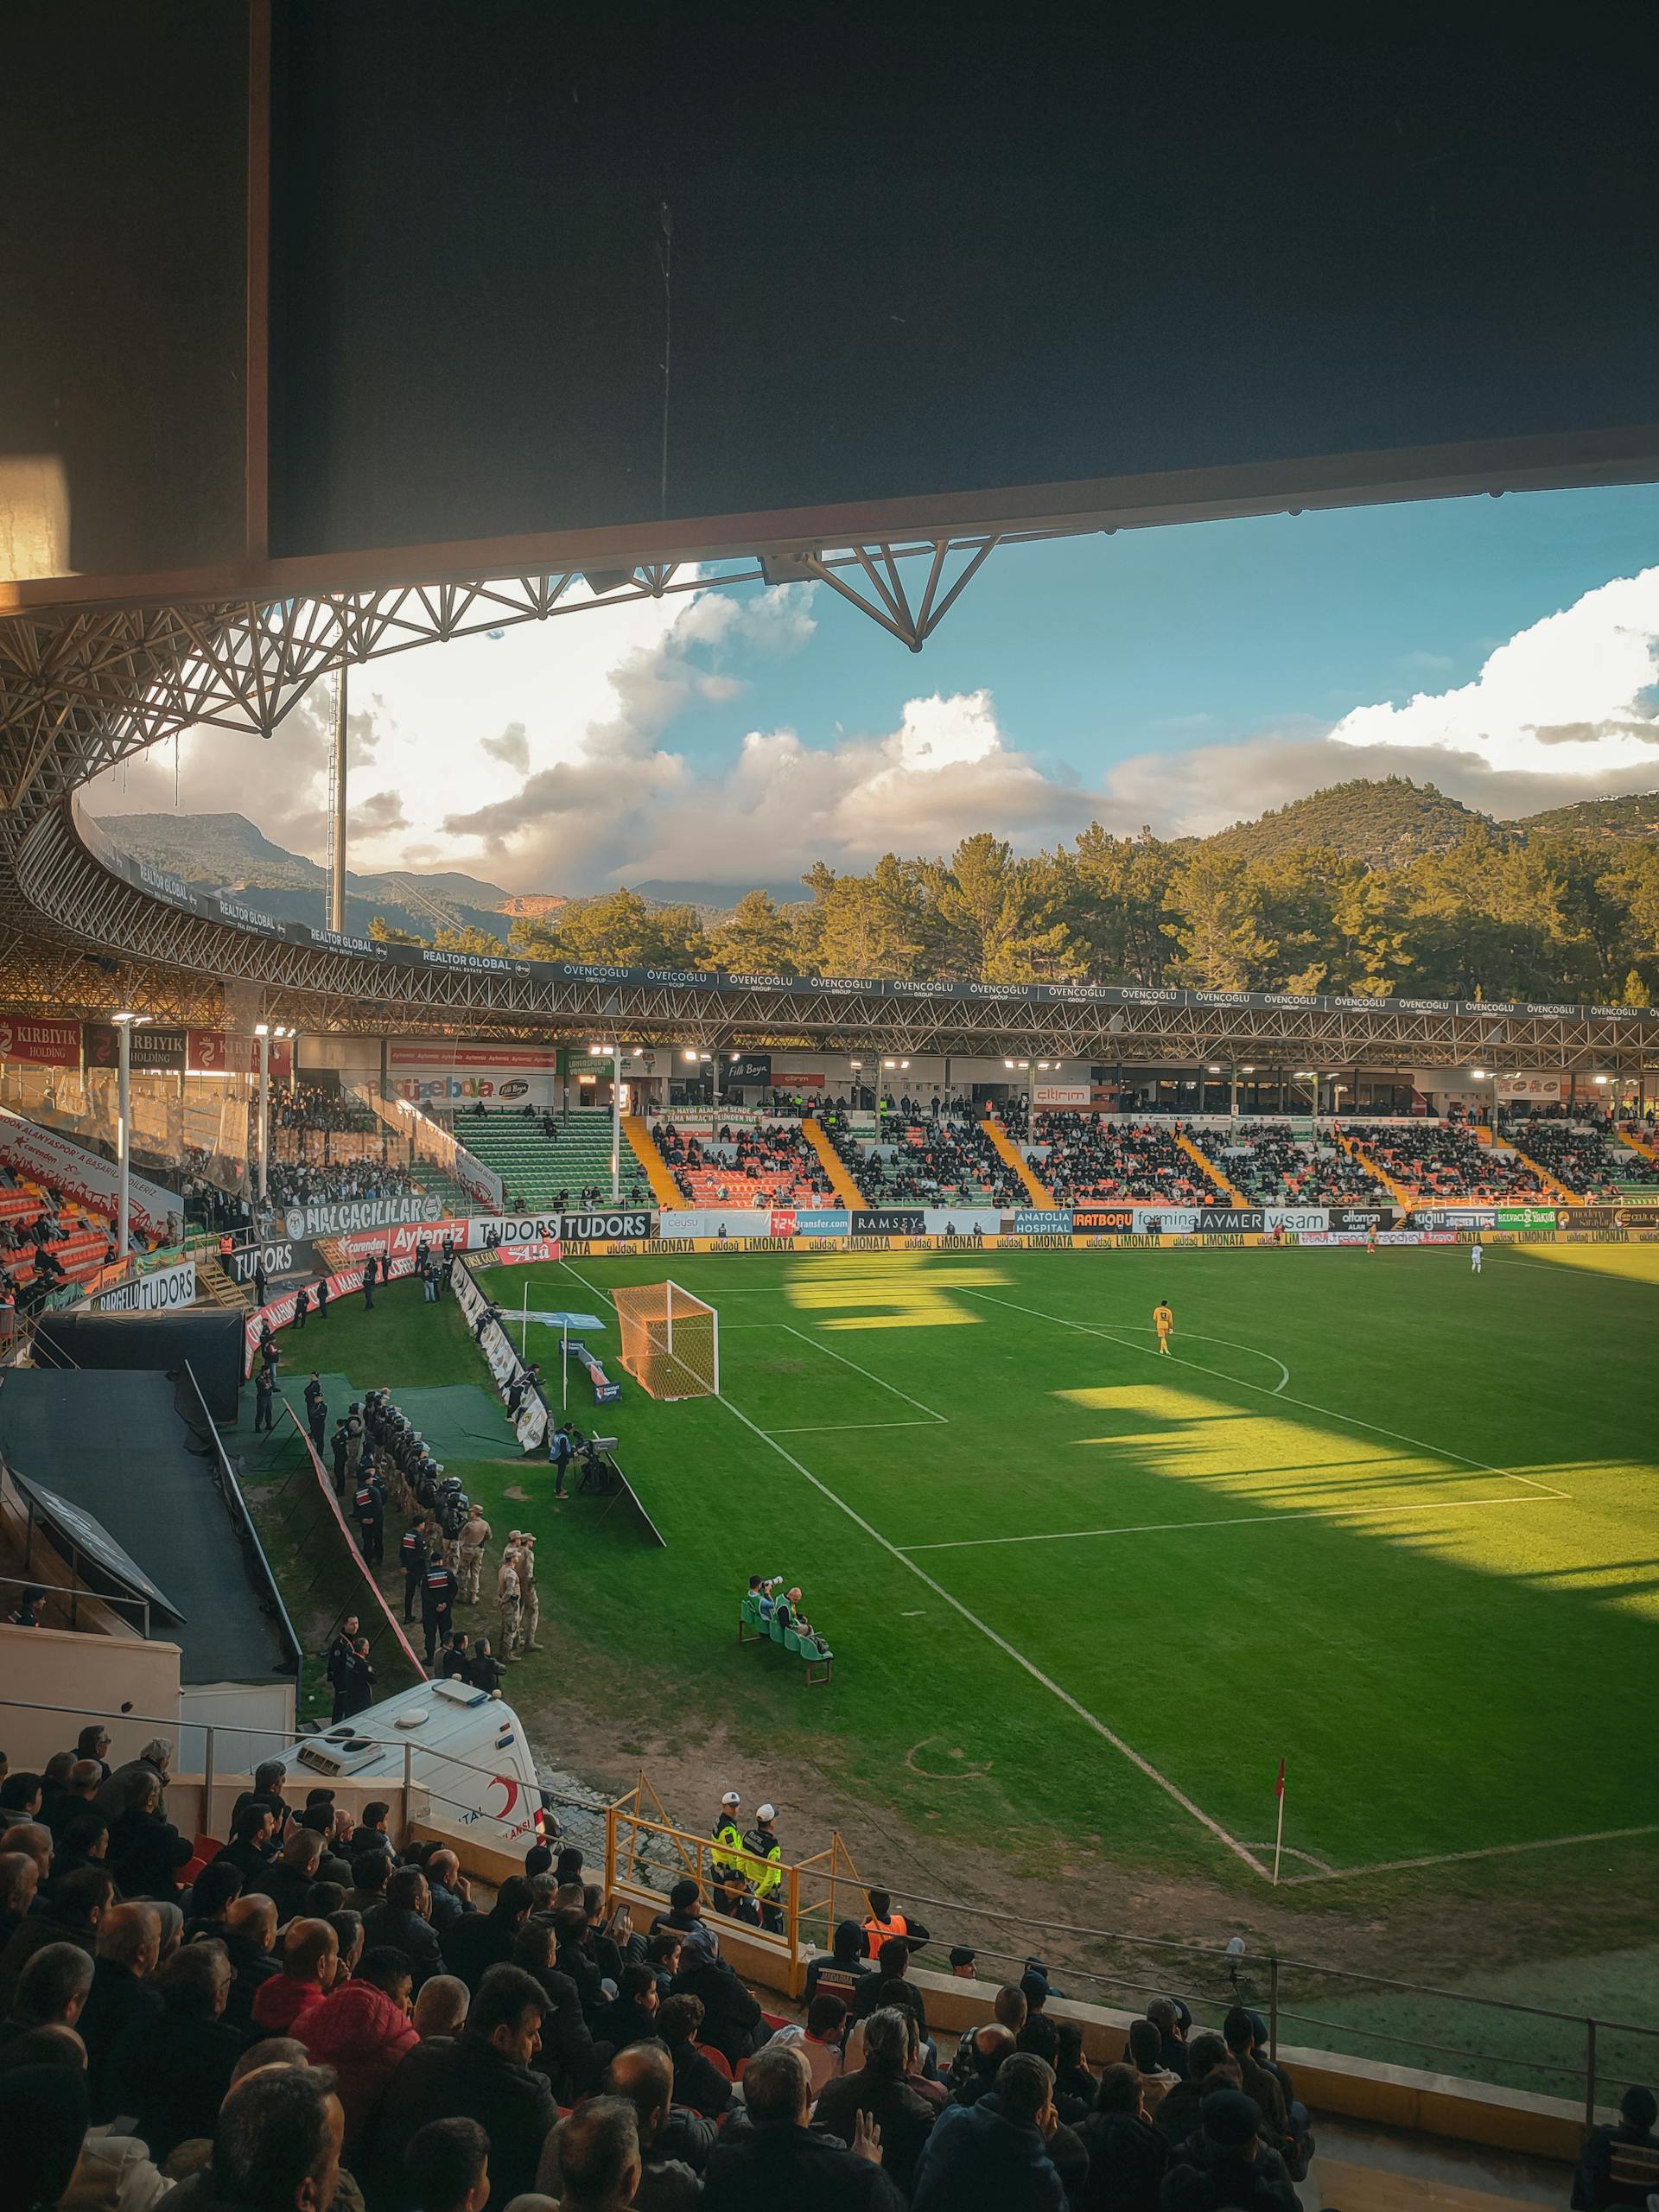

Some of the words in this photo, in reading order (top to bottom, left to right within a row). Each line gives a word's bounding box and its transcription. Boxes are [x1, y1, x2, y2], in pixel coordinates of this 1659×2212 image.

[140, 865, 164, 892] REALTOR
[164, 876, 188, 900] GLOBAL
[219, 900, 249, 921] REALTOR
[249, 912, 275, 930] GLOBAL
[311, 928, 342, 946] REALTOR
[343, 937, 372, 952] GLOBAL
[423, 950, 467, 965] REALTOR
[468, 957, 512, 970] GLOBAL
[17, 1027, 77, 1045] KIRBIYIK
[728, 1065, 743, 1077] Filli
[746, 1063, 767, 1077] Boya
[24, 1143, 57, 1165] corendon
[565, 1216, 646, 1238] TUDORS
[1016, 1224, 1070, 1233] HOSPITAL
[1204, 1214, 1262, 1228] AYMER
[349, 1238, 386, 1252] corendon
[393, 1224, 465, 1252] Aytemiz
[143, 1269, 192, 1310] TUDORS
